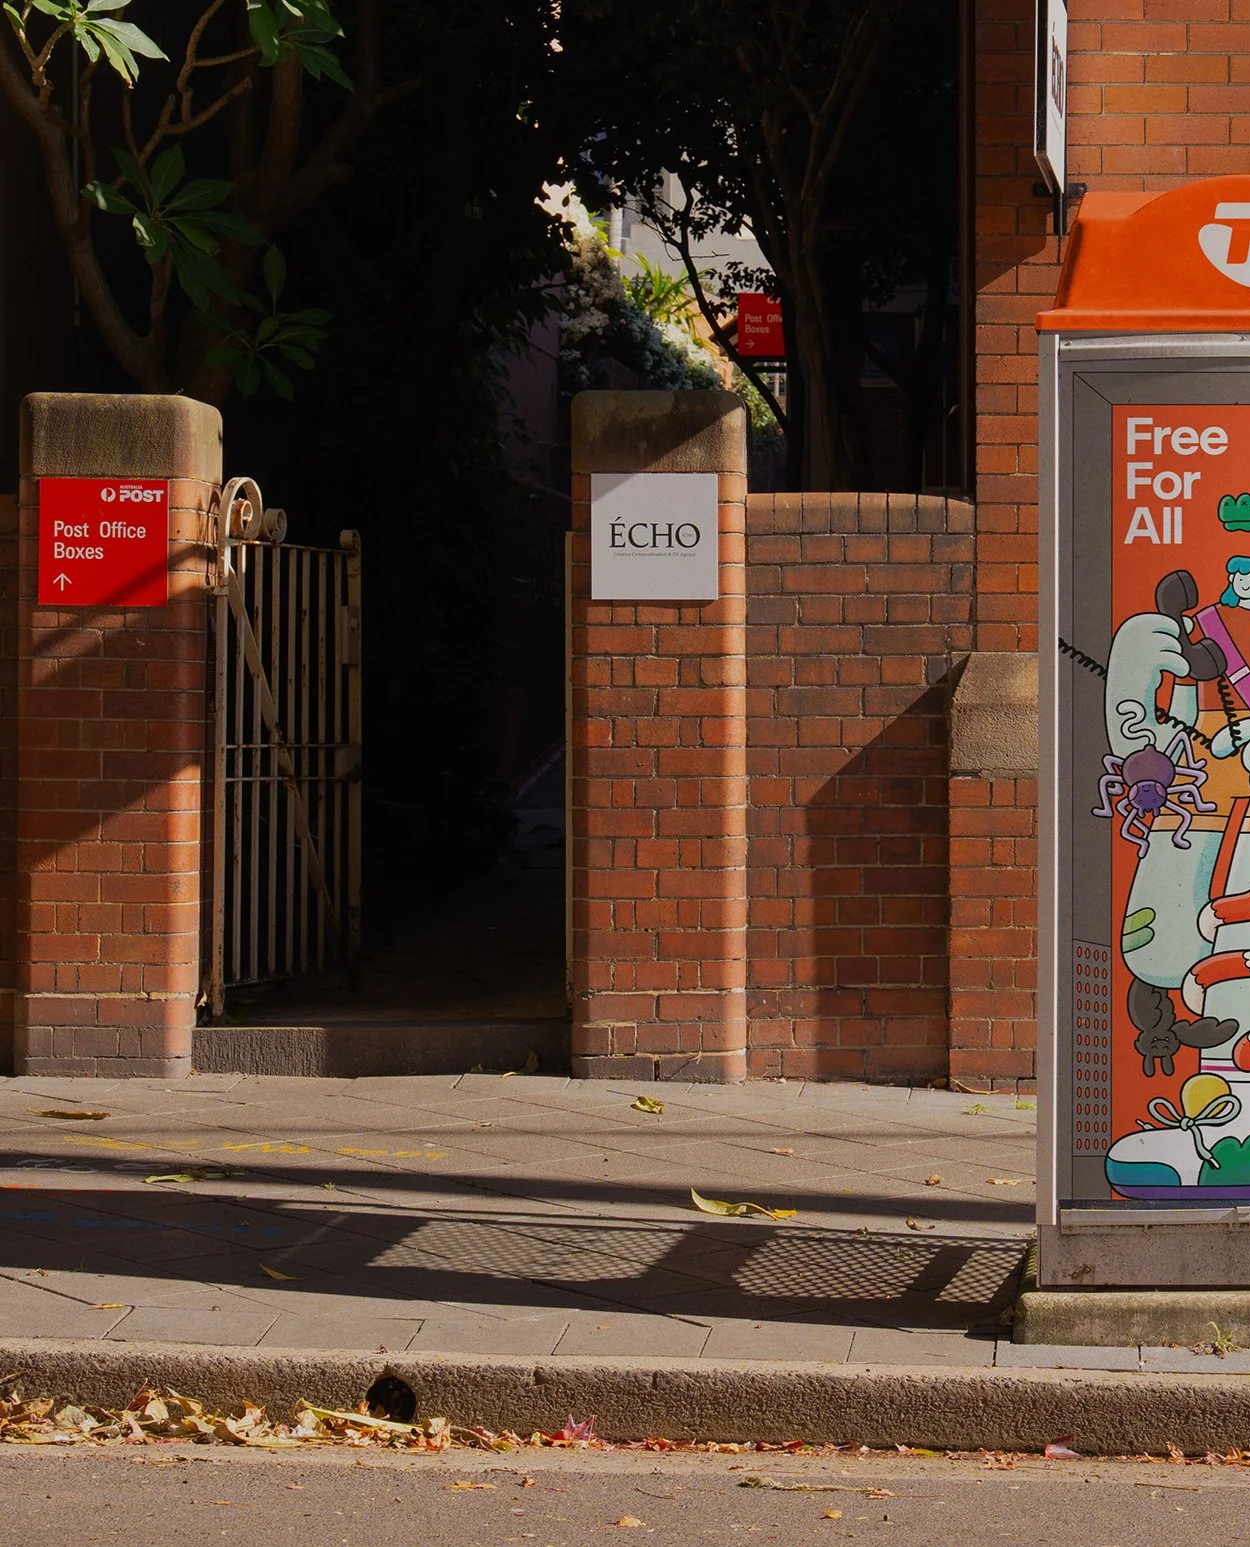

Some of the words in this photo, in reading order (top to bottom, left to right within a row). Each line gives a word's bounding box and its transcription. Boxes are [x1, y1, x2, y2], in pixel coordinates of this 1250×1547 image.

[745, 314, 762, 323] Post
[745, 325, 770, 334] Boxes
[1127, 417, 1229, 456] Free
[1126, 462, 1201, 500] For
[119, 489, 164, 503] POST
[54, 520, 89, 538] Post
[99, 521, 146, 539] Office
[609, 516, 701, 549] ÉCHO
[1124, 506, 1183, 545] All
[54, 542, 104, 560] Boxes
